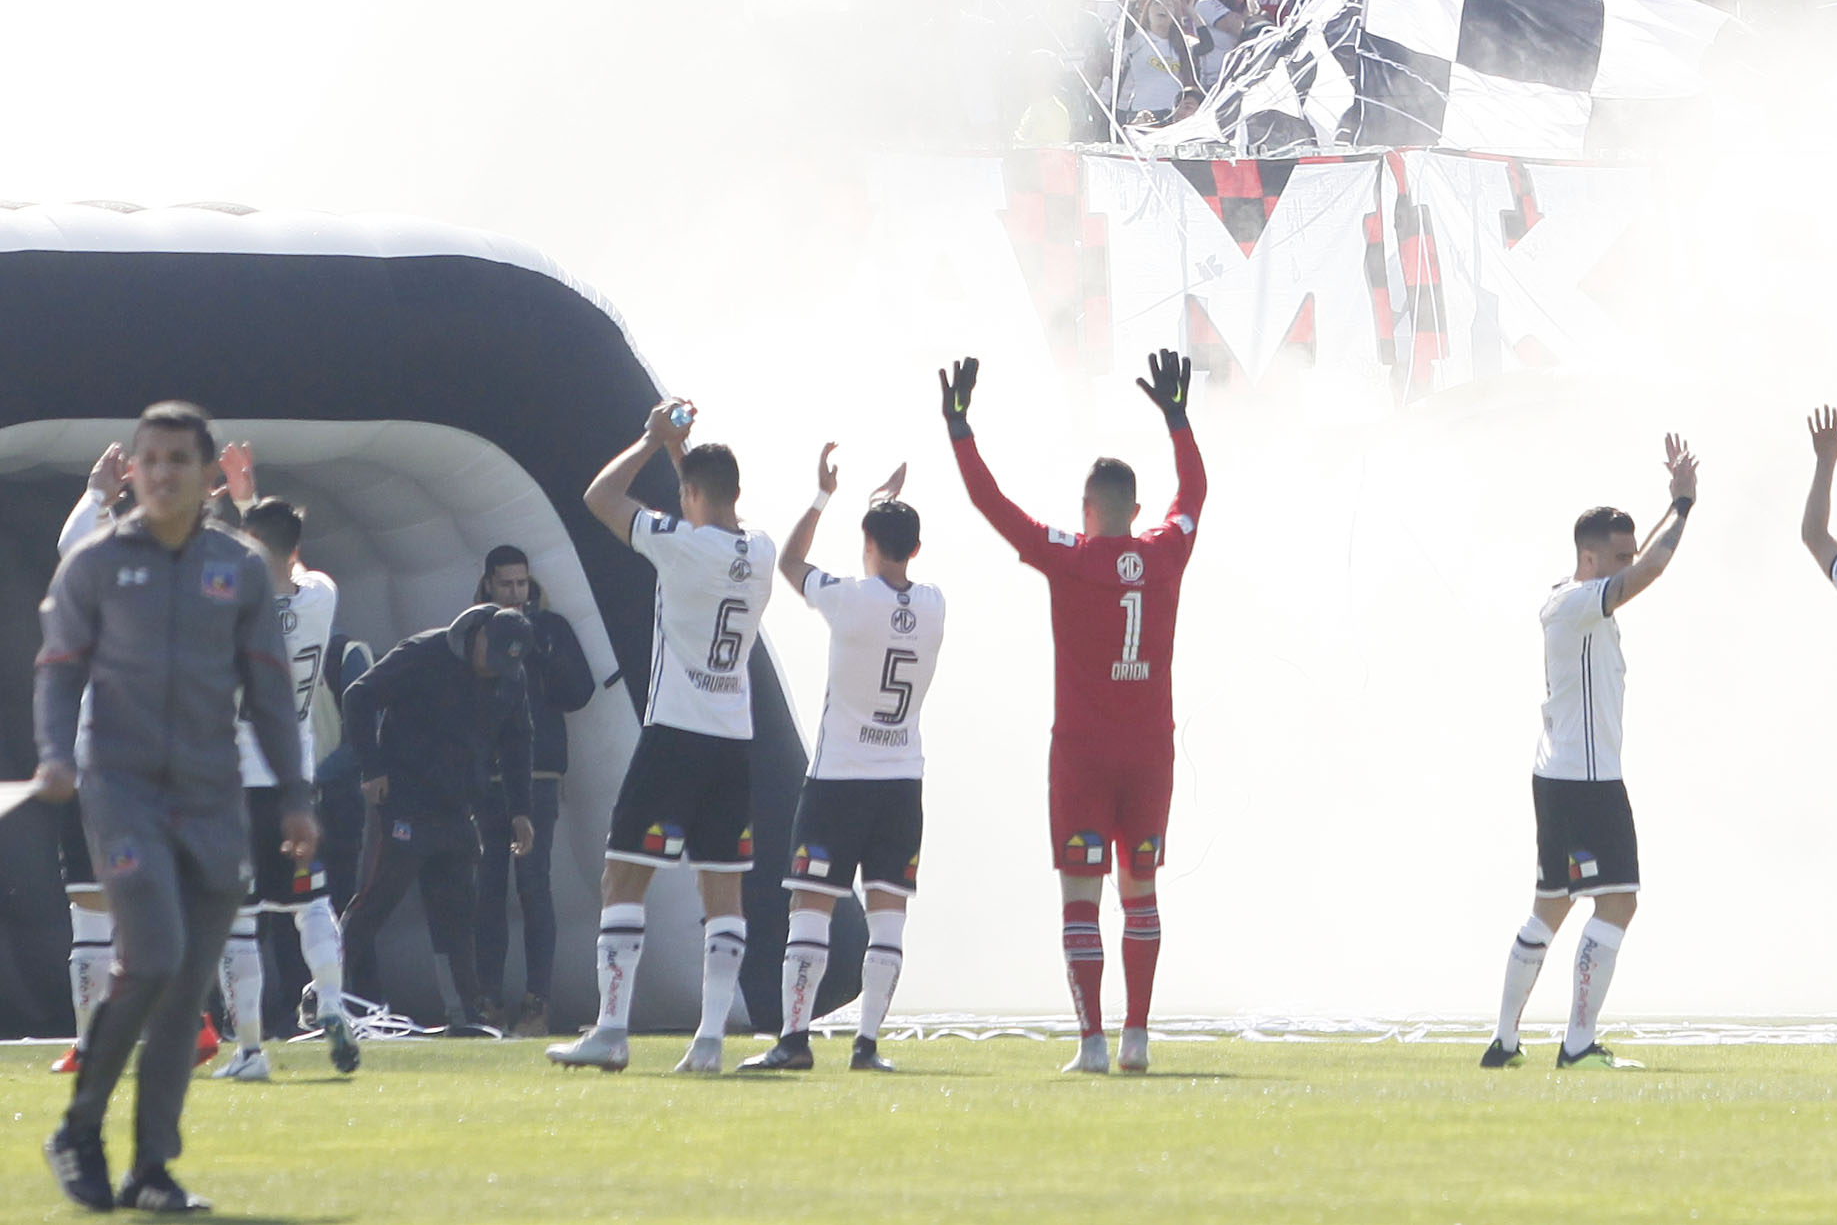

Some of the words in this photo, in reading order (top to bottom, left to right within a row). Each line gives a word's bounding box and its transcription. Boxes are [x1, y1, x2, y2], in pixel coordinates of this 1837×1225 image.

[707, 598, 748, 673] 6
[1120, 591, 1142, 662] 1
[872, 648, 918, 725] 5
[1111, 663, 1149, 681] ORION
